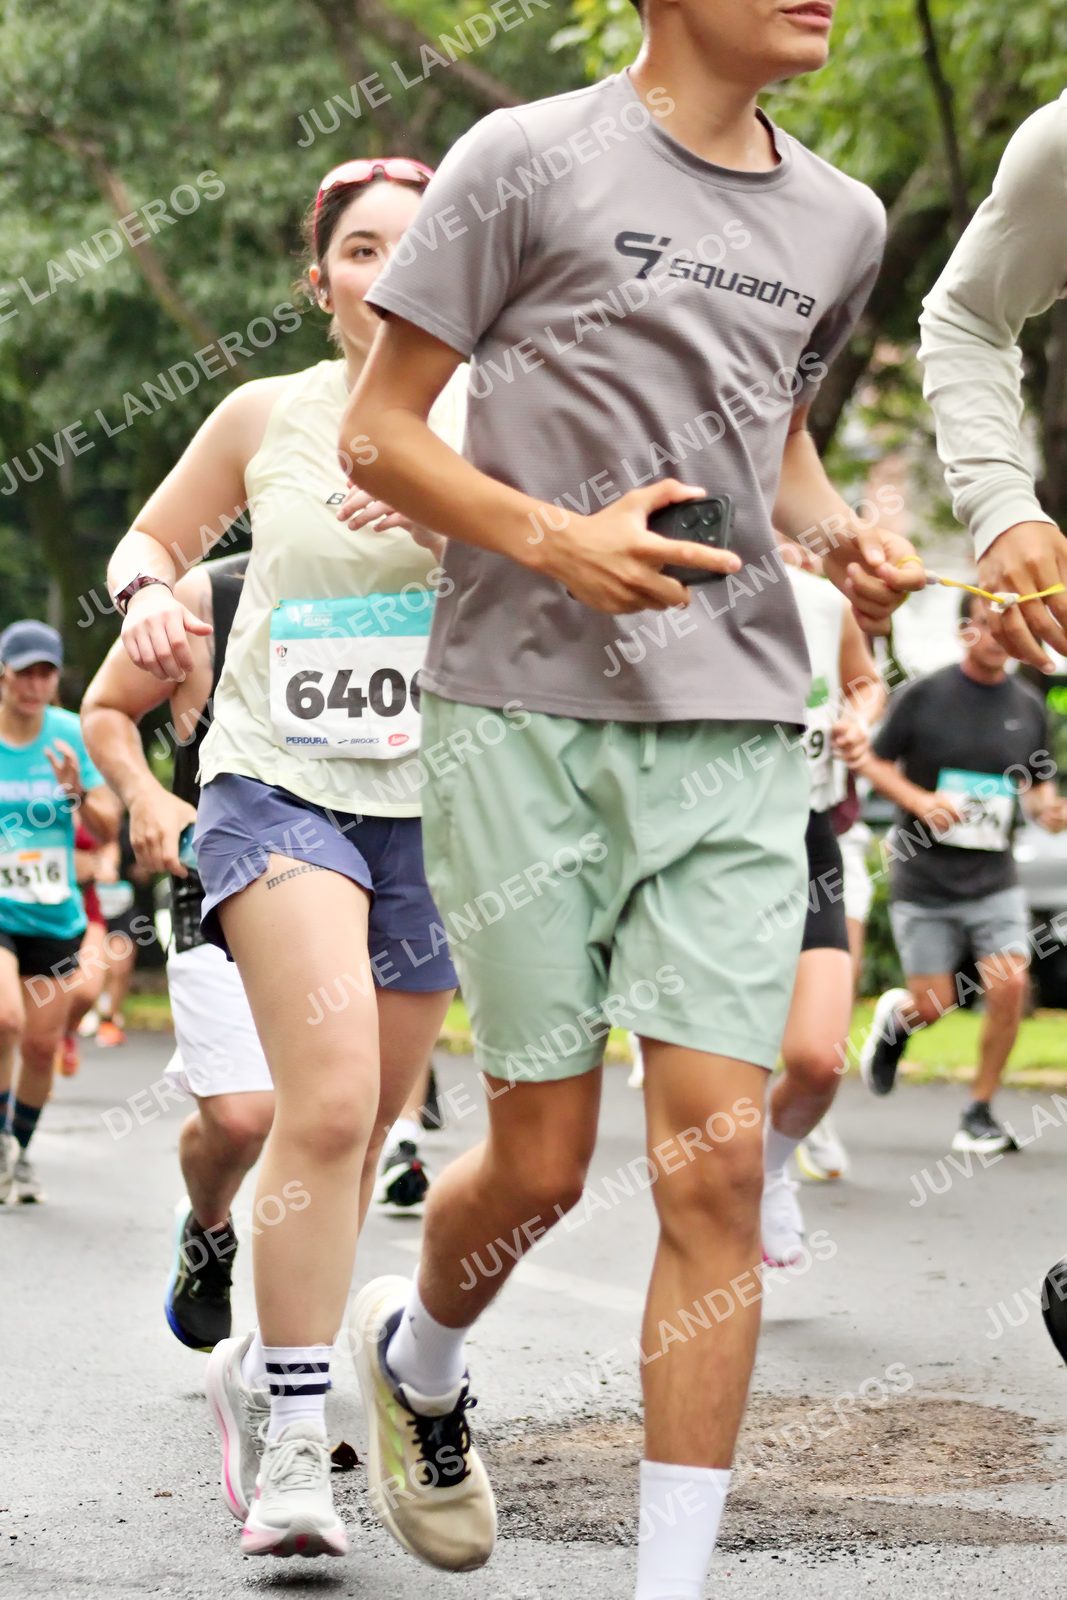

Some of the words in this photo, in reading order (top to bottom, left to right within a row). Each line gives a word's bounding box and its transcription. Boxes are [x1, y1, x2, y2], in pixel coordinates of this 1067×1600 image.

[669, 258, 816, 318] squadra
[286, 736, 328, 745] PERDURA
[802, 730, 824, 758] 9
